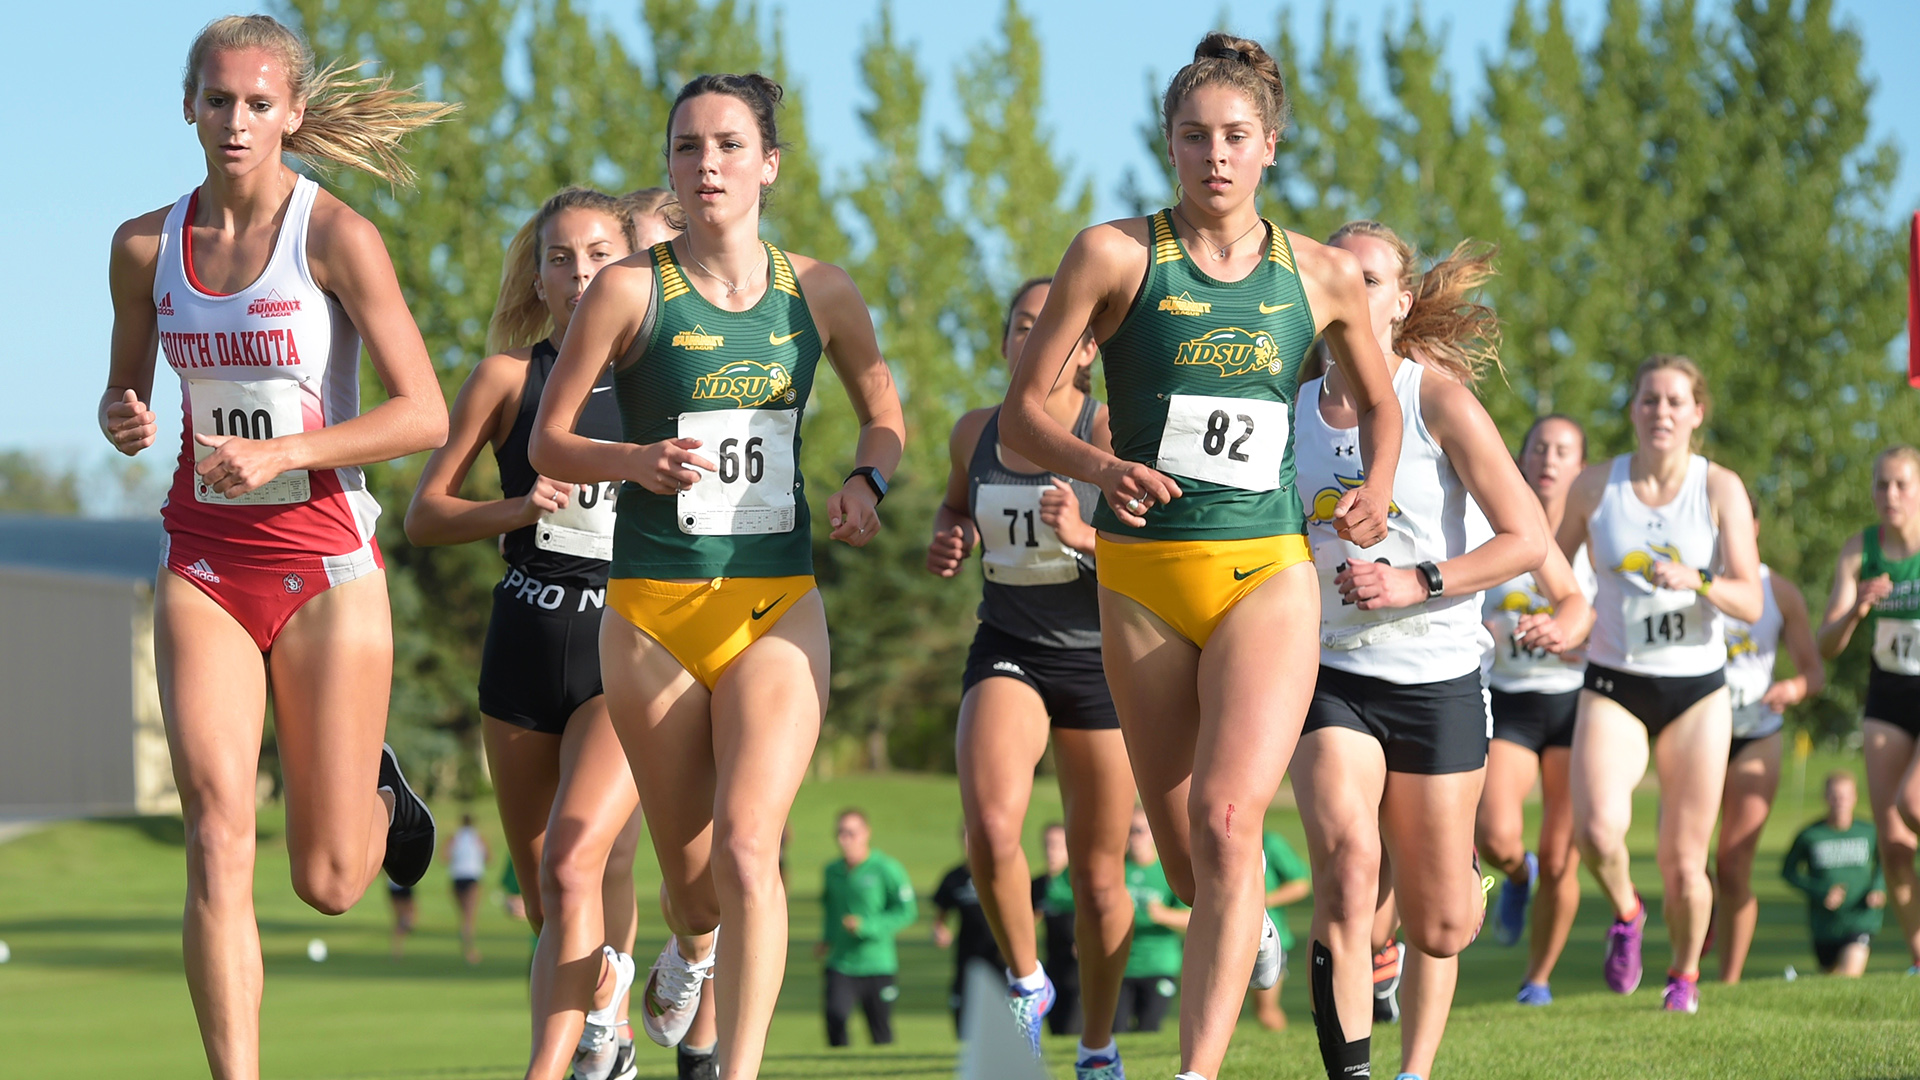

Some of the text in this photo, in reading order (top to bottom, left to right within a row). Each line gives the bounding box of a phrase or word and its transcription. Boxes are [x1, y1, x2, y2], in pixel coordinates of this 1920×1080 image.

[247, 300, 302, 315] SUMMIT
[215, 328, 301, 367] DAKOTA
[1174, 343, 1254, 366] NDSU
[692, 376, 768, 400] NDSU
[212, 407, 274, 440] 100
[1203, 409, 1254, 462] 82
[719, 436, 764, 484] 66
[1003, 509, 1039, 547] 71
[503, 568, 566, 611] PRO
[1644, 612, 1687, 644] 143
